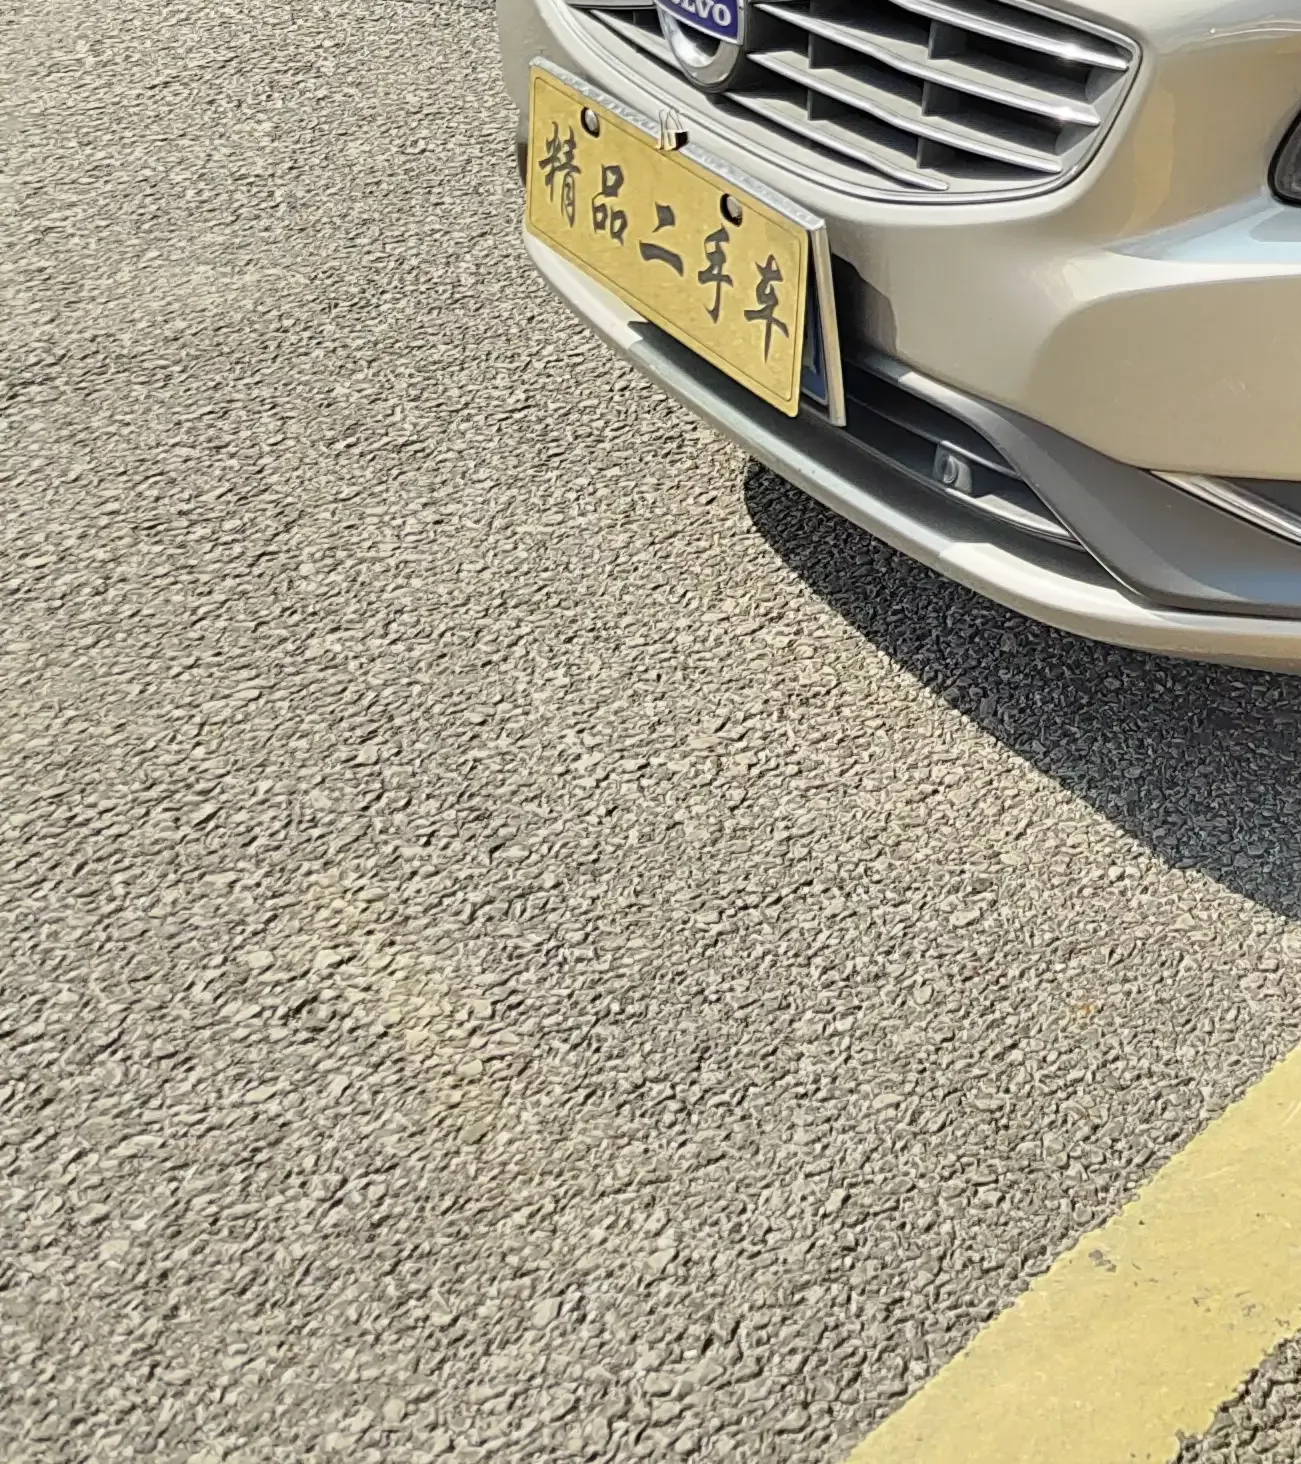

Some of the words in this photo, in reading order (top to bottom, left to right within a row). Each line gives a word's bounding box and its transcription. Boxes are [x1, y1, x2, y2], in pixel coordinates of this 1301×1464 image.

[538, 120, 790, 364] 精品二手车
